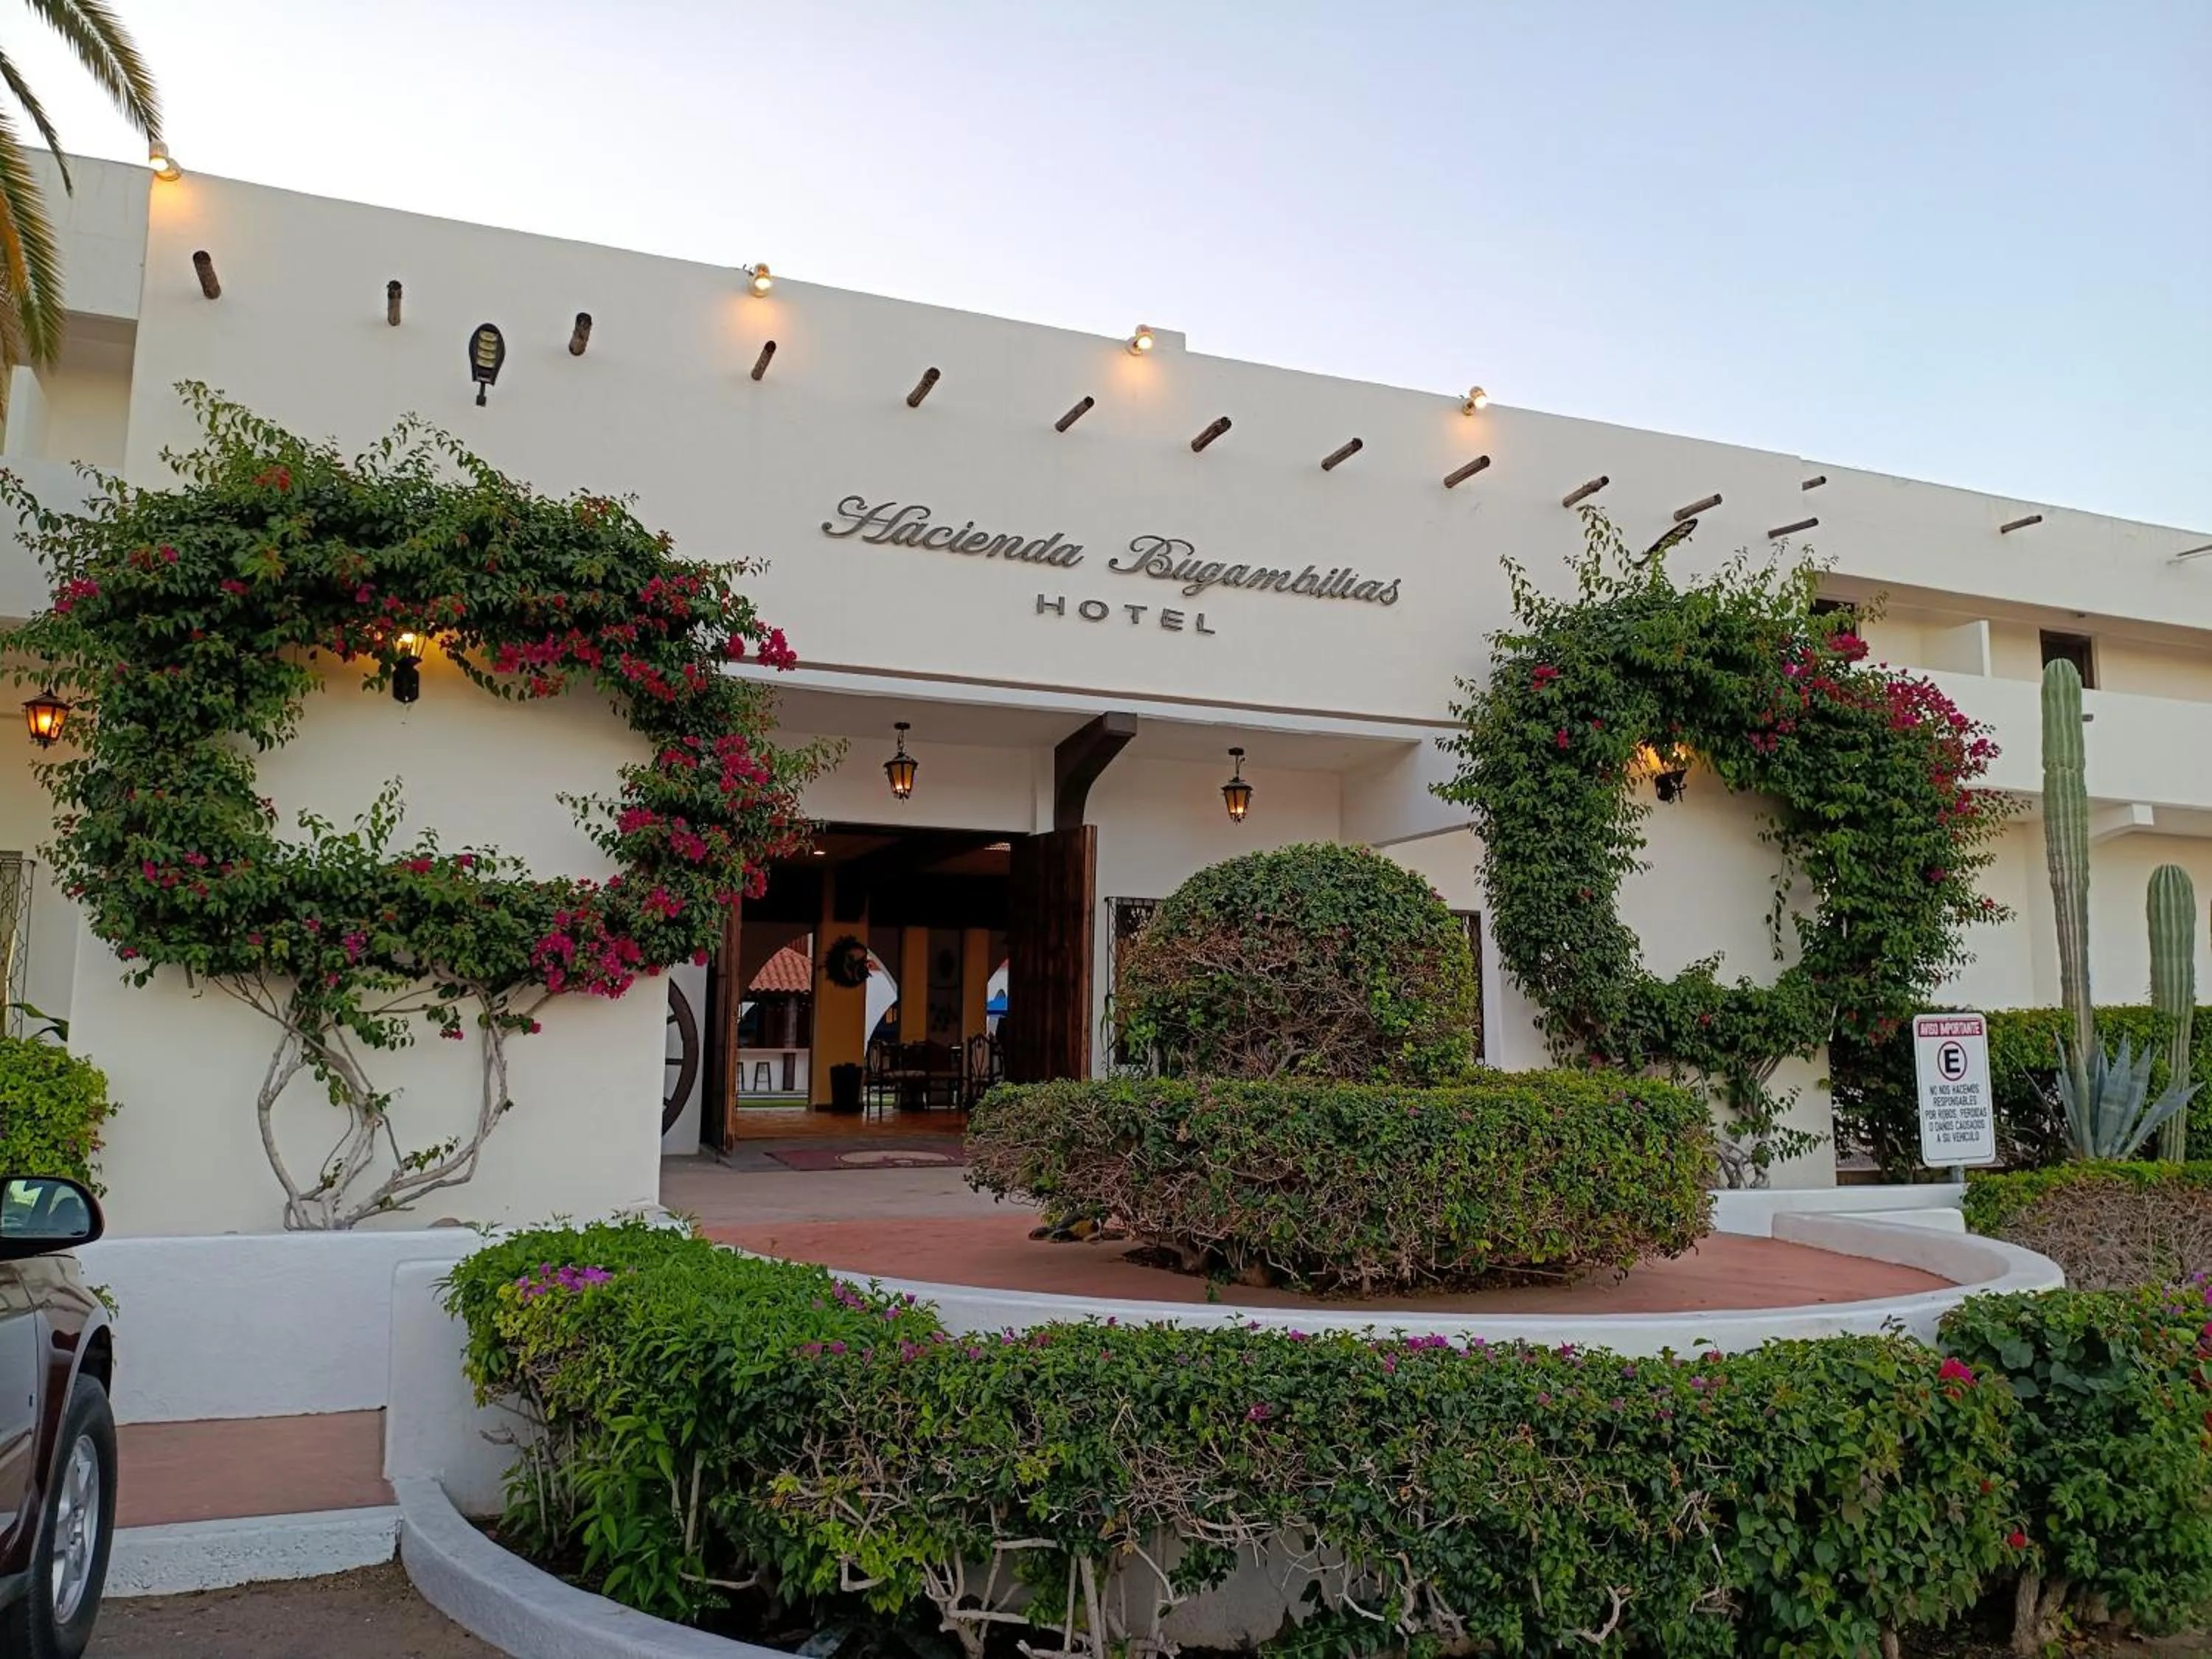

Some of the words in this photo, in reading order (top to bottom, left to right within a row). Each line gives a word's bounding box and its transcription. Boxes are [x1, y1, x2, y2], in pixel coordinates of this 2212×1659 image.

[821, 495, 1085, 568] Hacienda
[1108, 535, 1402, 608] Bugambilias
[1035, 594, 1217, 636] HOTEL
[1944, 1048, 1961, 1074] E
